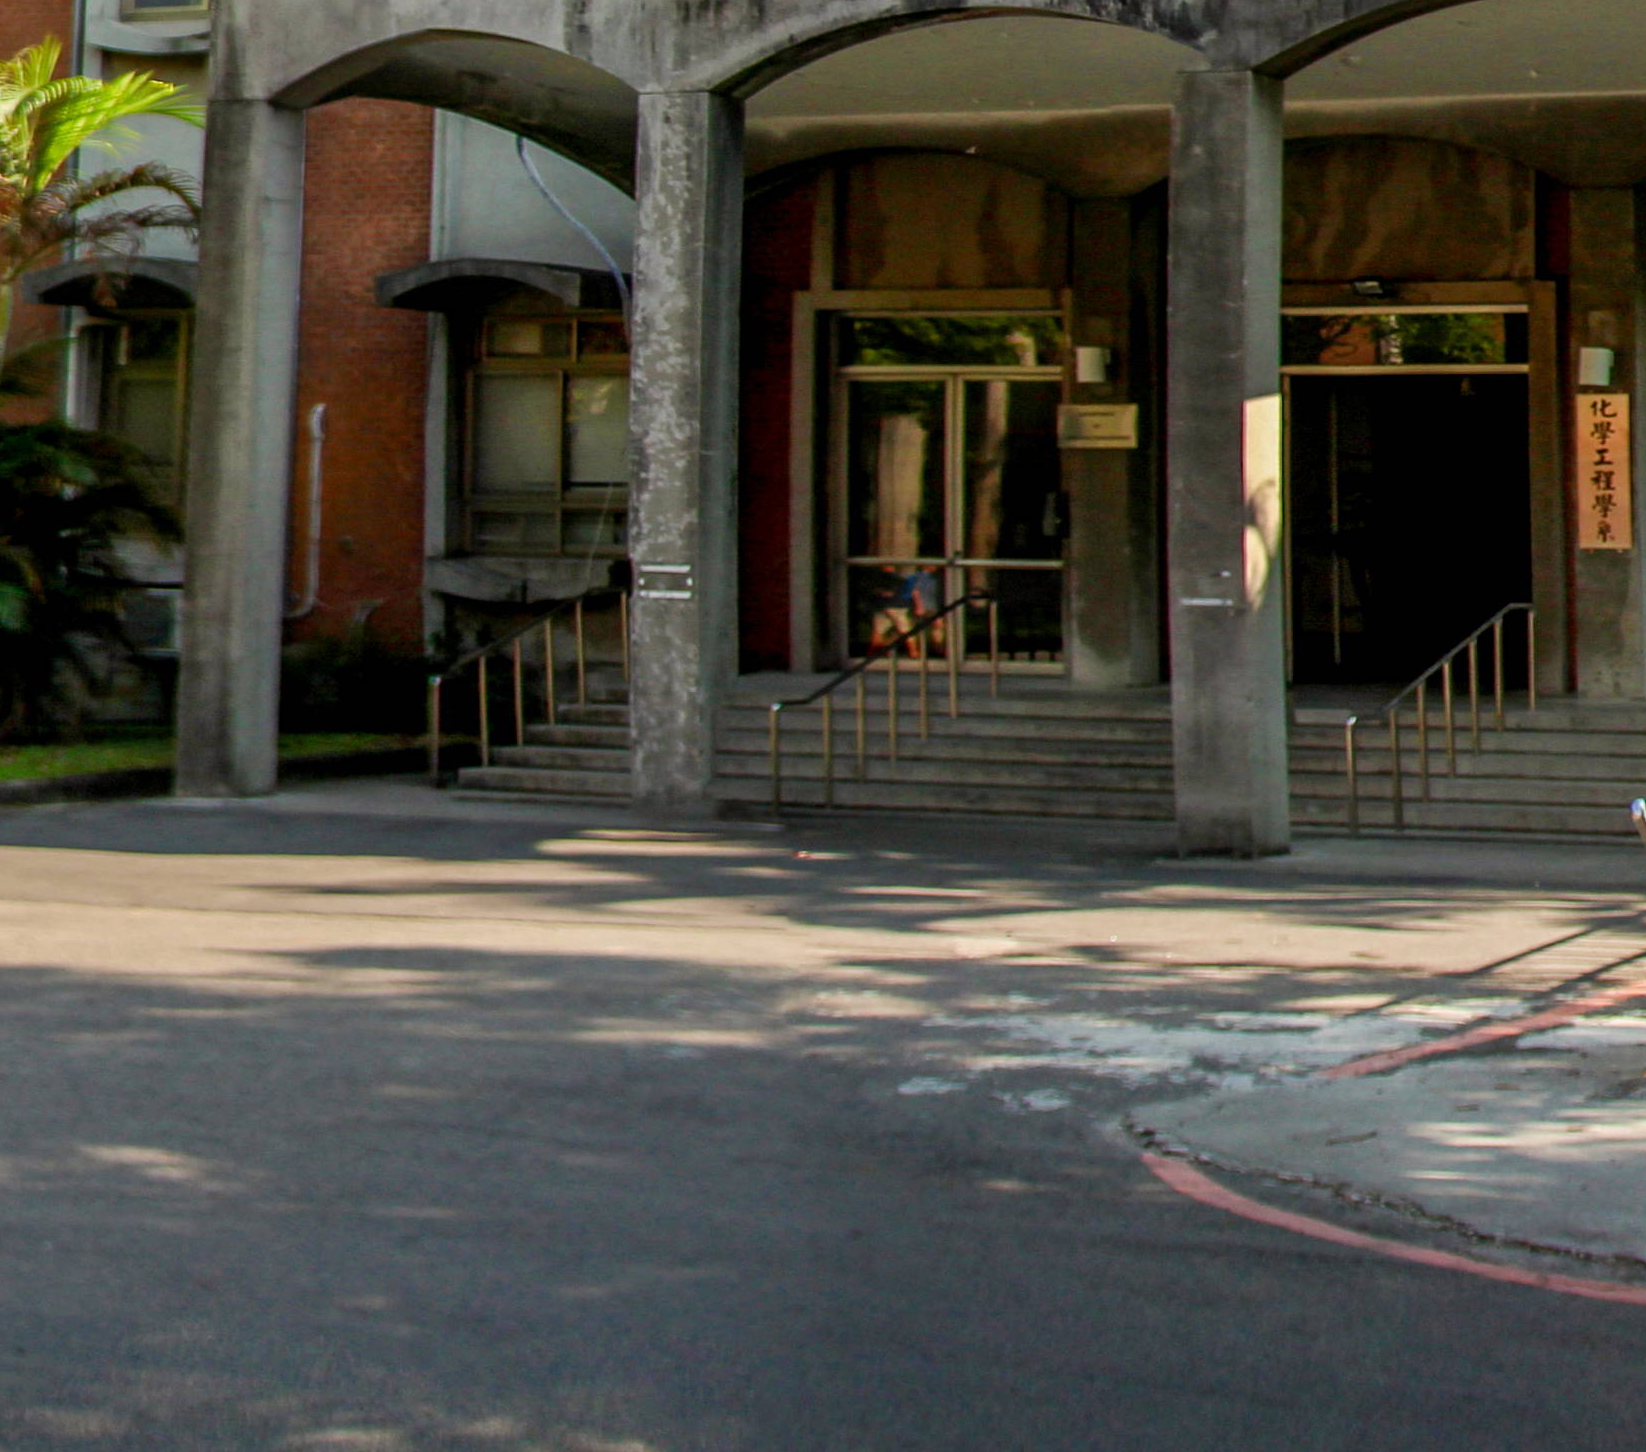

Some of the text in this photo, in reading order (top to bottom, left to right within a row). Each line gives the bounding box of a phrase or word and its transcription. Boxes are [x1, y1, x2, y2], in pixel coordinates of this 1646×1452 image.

[1590, 398, 1618, 543] 化學工程學系
